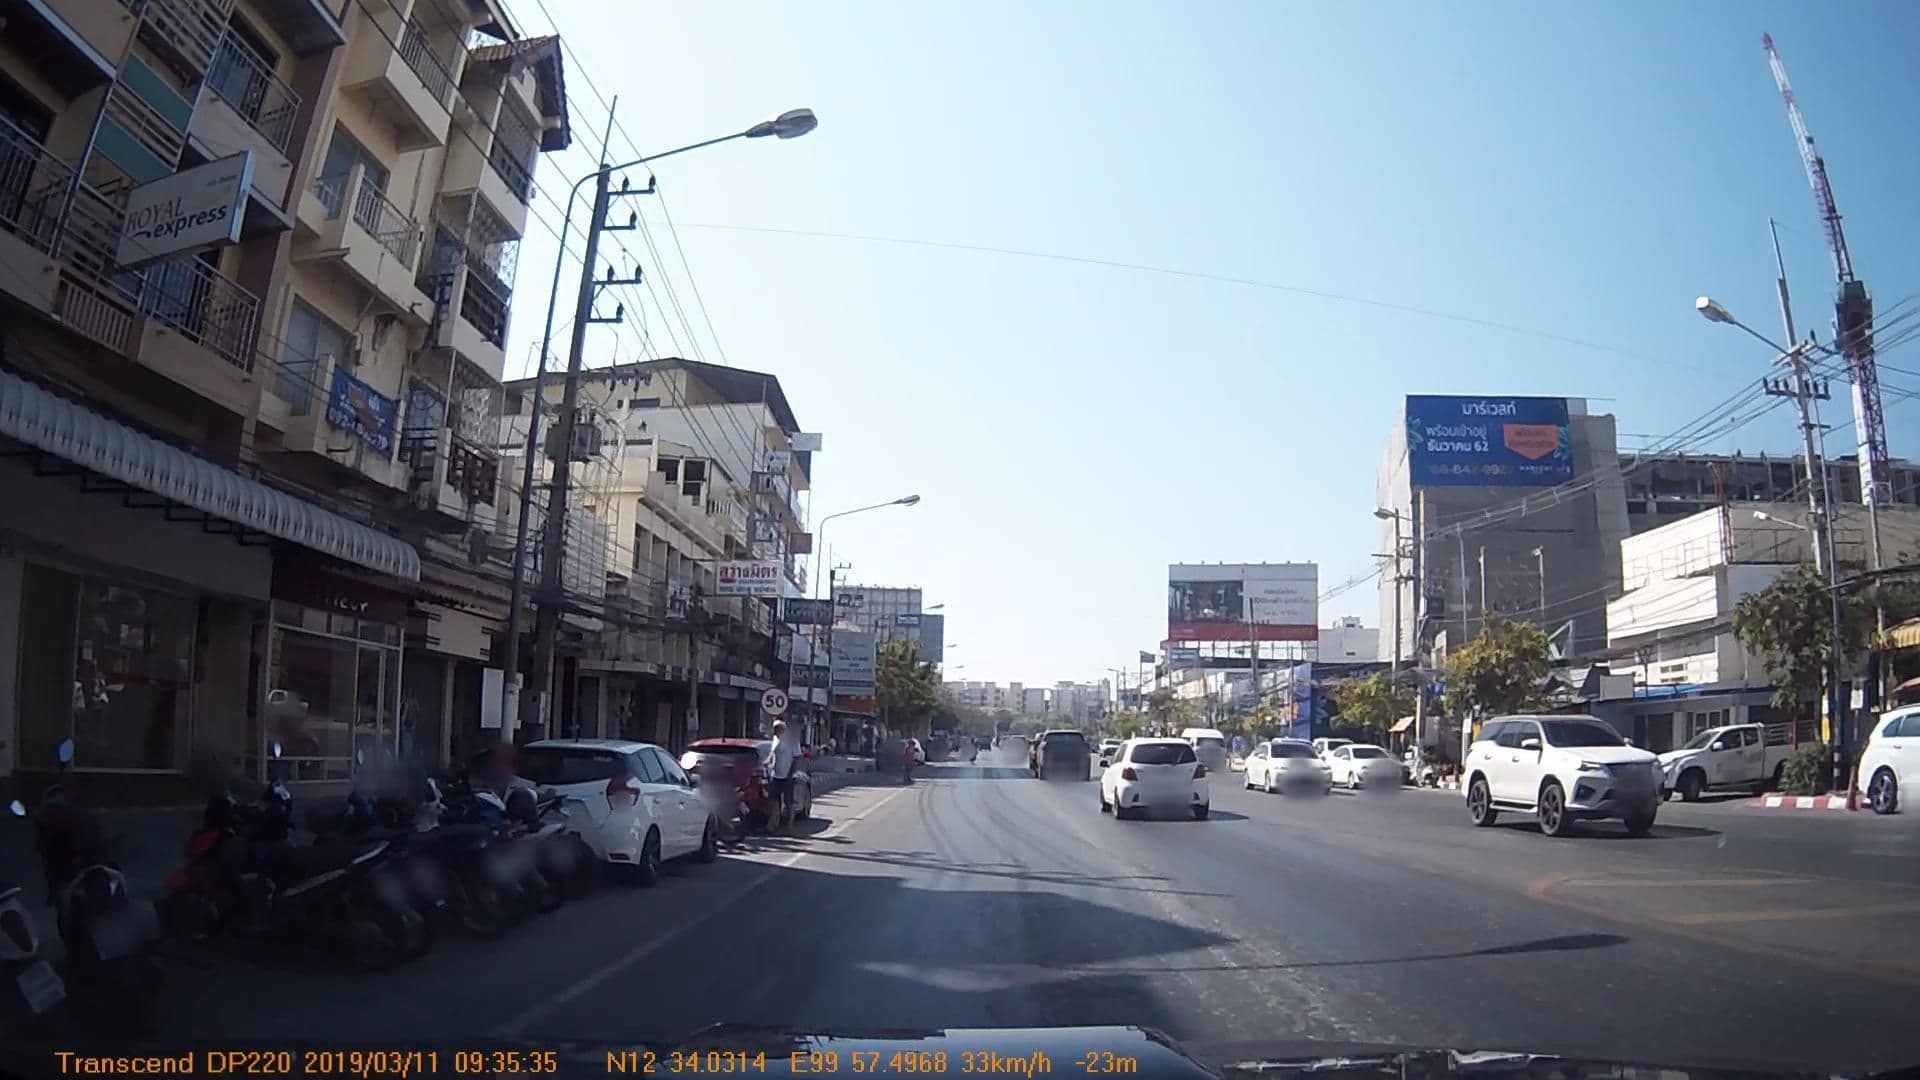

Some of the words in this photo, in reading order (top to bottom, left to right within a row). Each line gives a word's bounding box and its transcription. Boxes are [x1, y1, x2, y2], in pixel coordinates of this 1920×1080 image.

[126, 196, 184, 233] ROYAL
[153, 204, 228, 238] express
[1474, 440, 1489, 452] 62
[765, 695, 785, 708] 50
